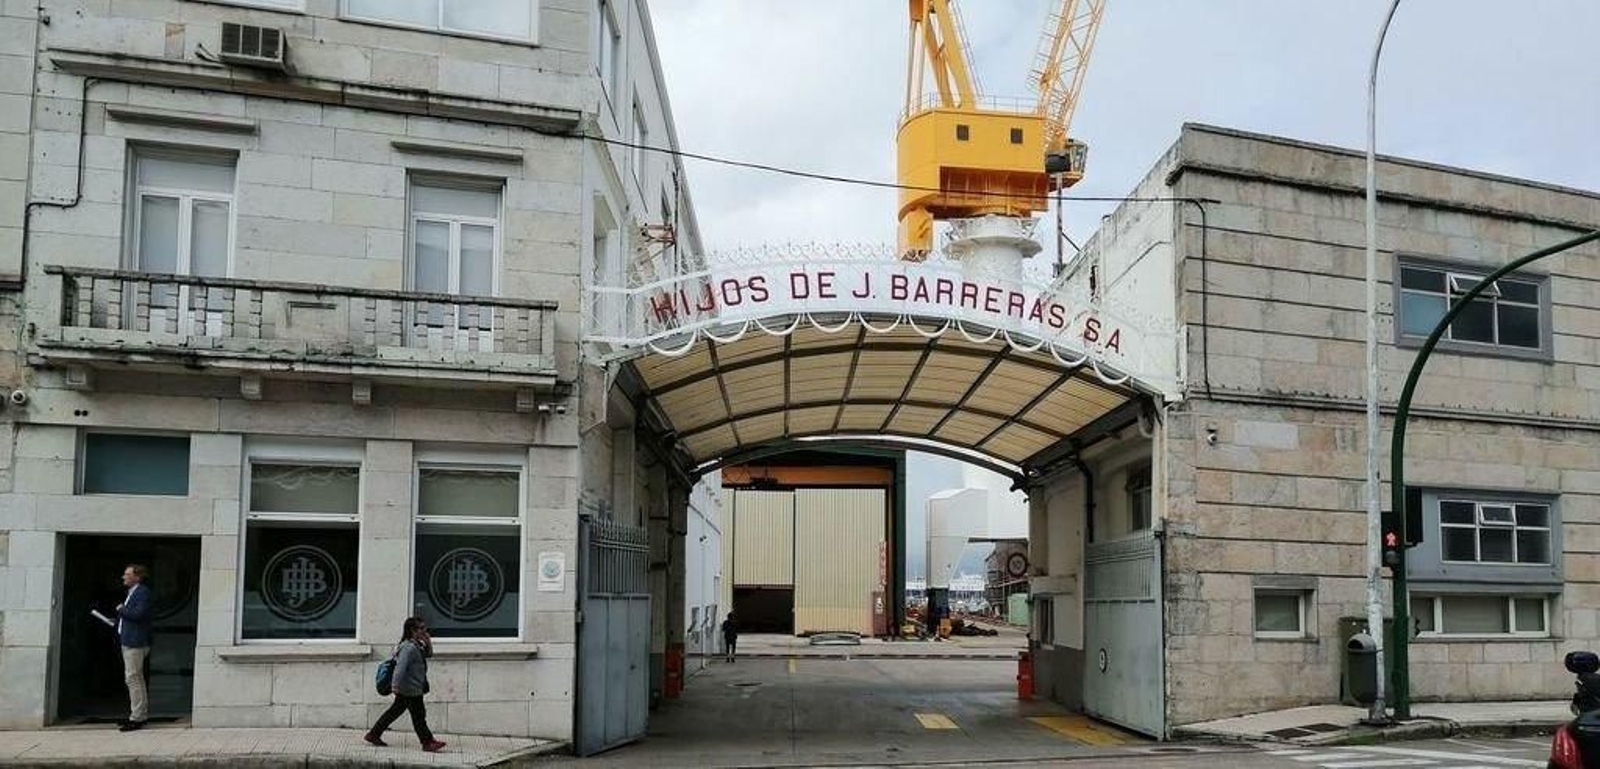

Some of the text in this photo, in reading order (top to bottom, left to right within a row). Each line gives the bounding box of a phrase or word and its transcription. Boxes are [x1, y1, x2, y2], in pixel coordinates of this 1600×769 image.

[651, 275, 769, 324] HIJOS
[790, 272, 837, 300] DE
[852, 272, 876, 299] J.
[891, 274, 1065, 329] BARRERAS
